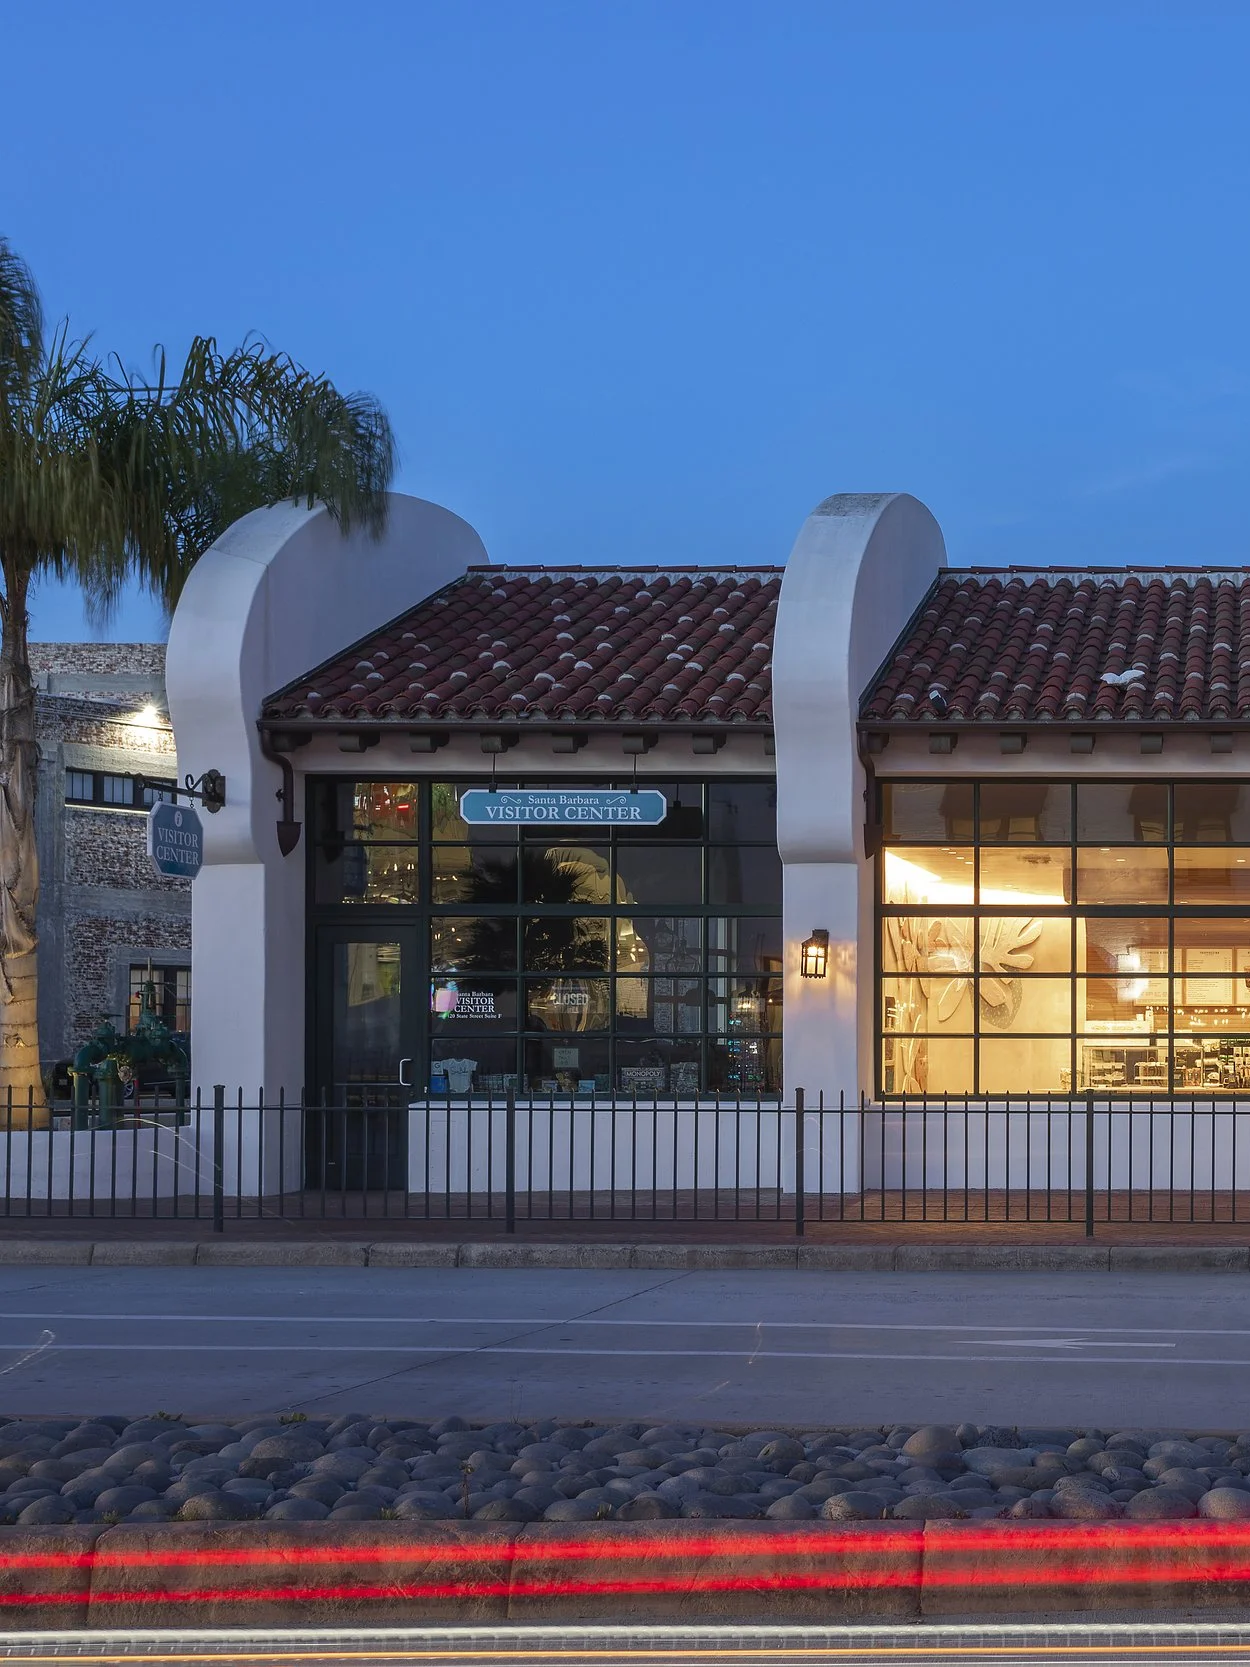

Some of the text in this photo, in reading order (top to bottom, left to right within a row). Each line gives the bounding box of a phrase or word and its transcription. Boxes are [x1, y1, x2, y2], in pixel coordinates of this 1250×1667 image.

[528, 795, 599, 805] Santa Barbara
[486, 806, 642, 820] VISITOR CENTER
[158, 827, 198, 848] VISITOR
[156, 845, 199, 866] CENTER
[456, 997, 495, 1005] VISITOR
[553, 993, 588, 1006] CLOSED
[454, 1005, 495, 1013] CENTER
[626, 1070, 661, 1078] MONOPOLY
